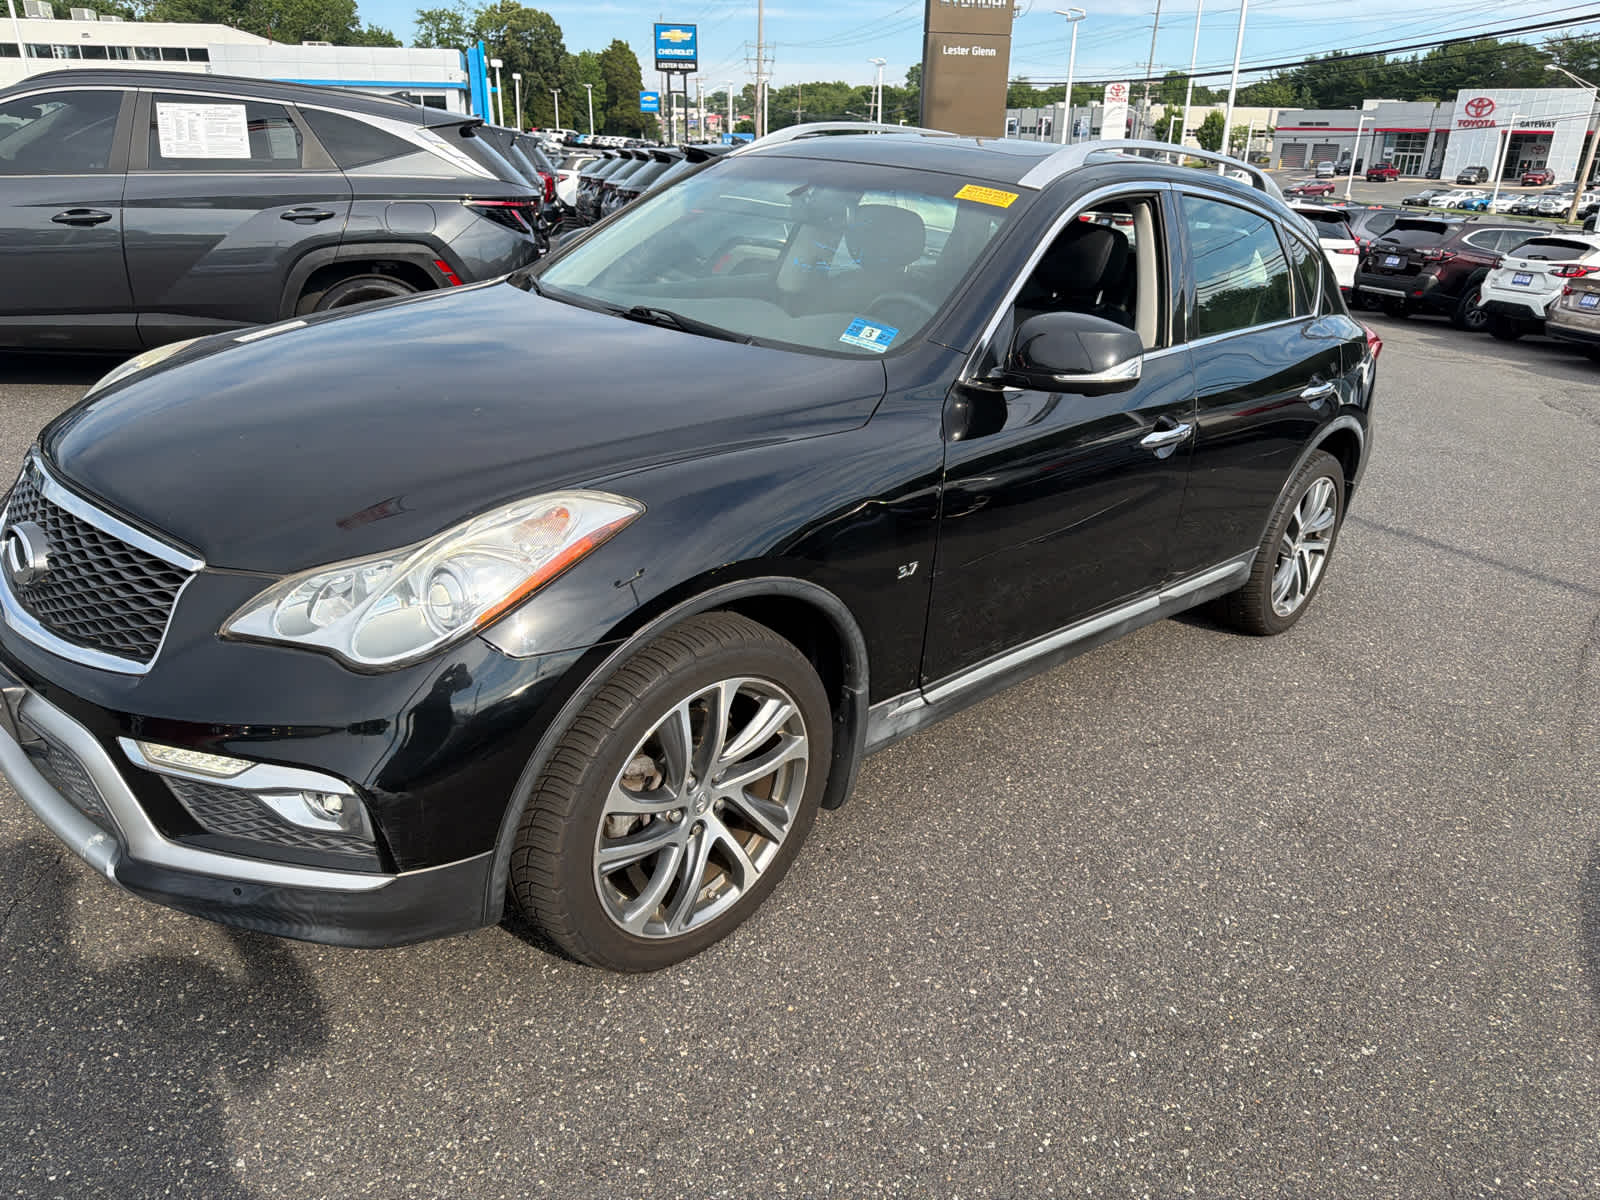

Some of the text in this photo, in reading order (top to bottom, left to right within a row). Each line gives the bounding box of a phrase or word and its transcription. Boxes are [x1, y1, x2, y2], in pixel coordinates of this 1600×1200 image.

[658, 48, 694, 56] CHEVROLET
[943, 45, 996, 56] Lester Glenn
[1457, 119, 1496, 128] TOYOTA
[1519, 120, 1557, 128] GATEWAY
[865, 329, 874, 338] 3
[897, 560, 919, 580] 3.7
